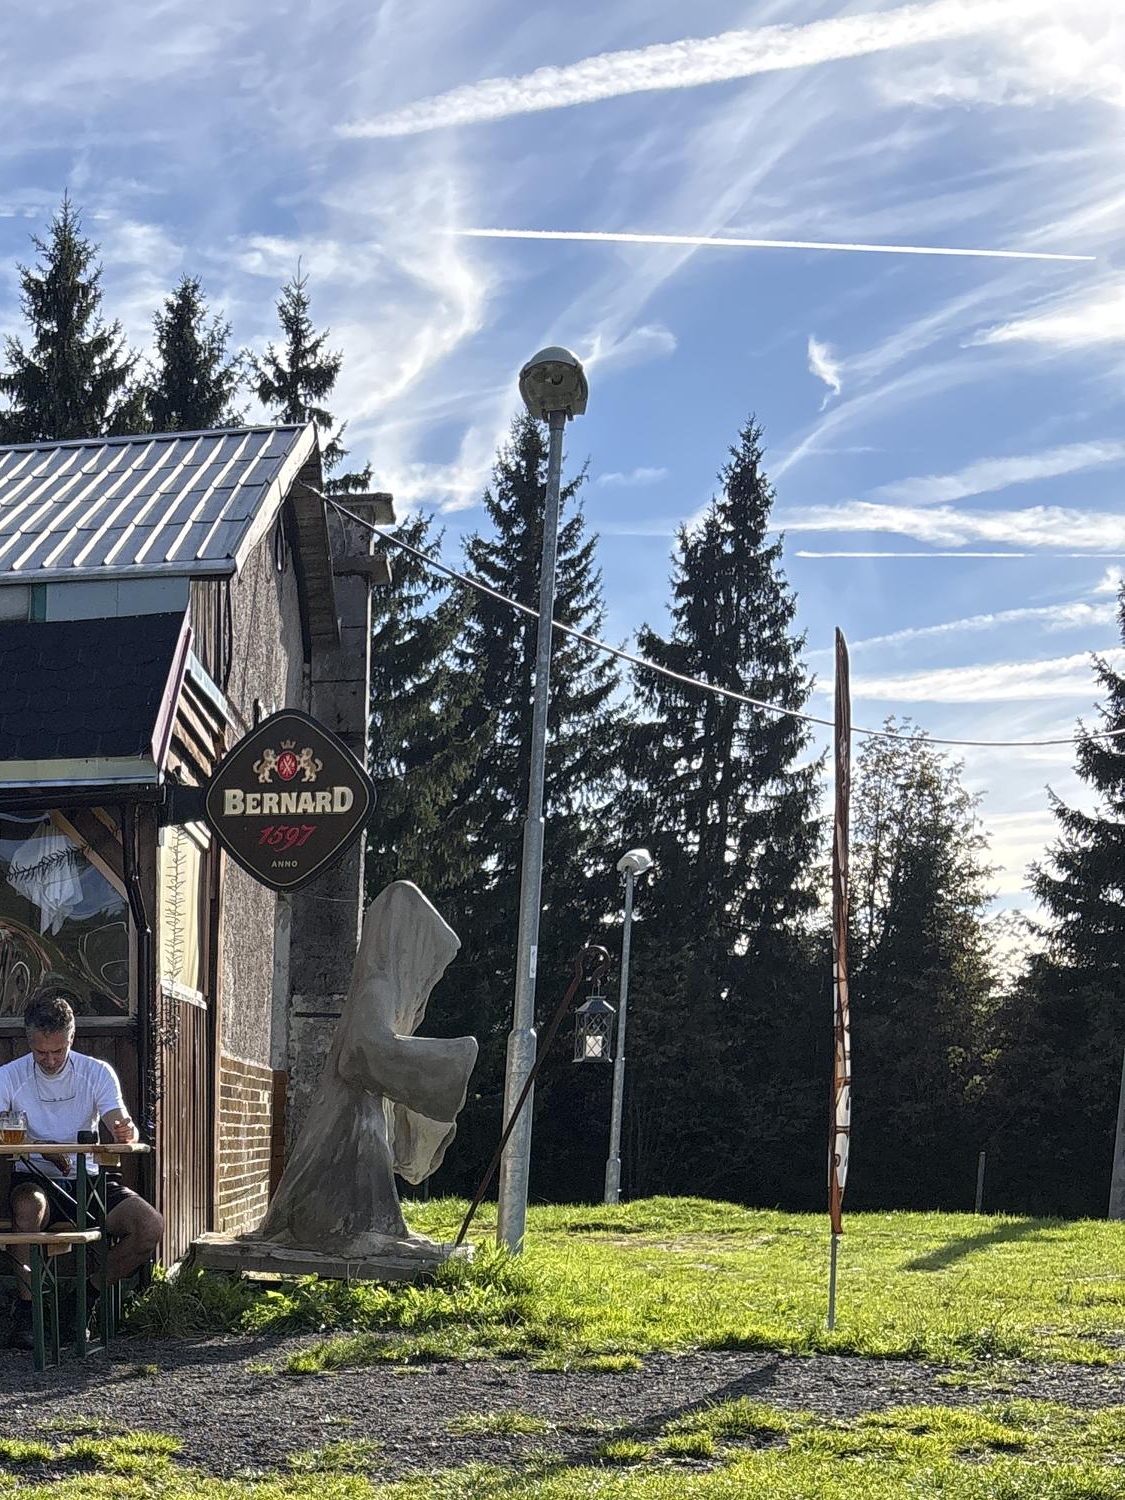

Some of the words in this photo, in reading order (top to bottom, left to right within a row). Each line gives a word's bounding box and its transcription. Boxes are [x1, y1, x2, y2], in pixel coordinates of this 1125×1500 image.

[223, 786, 354, 816] BERNARD
[258, 824, 316, 852] 1597
[271, 860, 298, 868] ANNO
